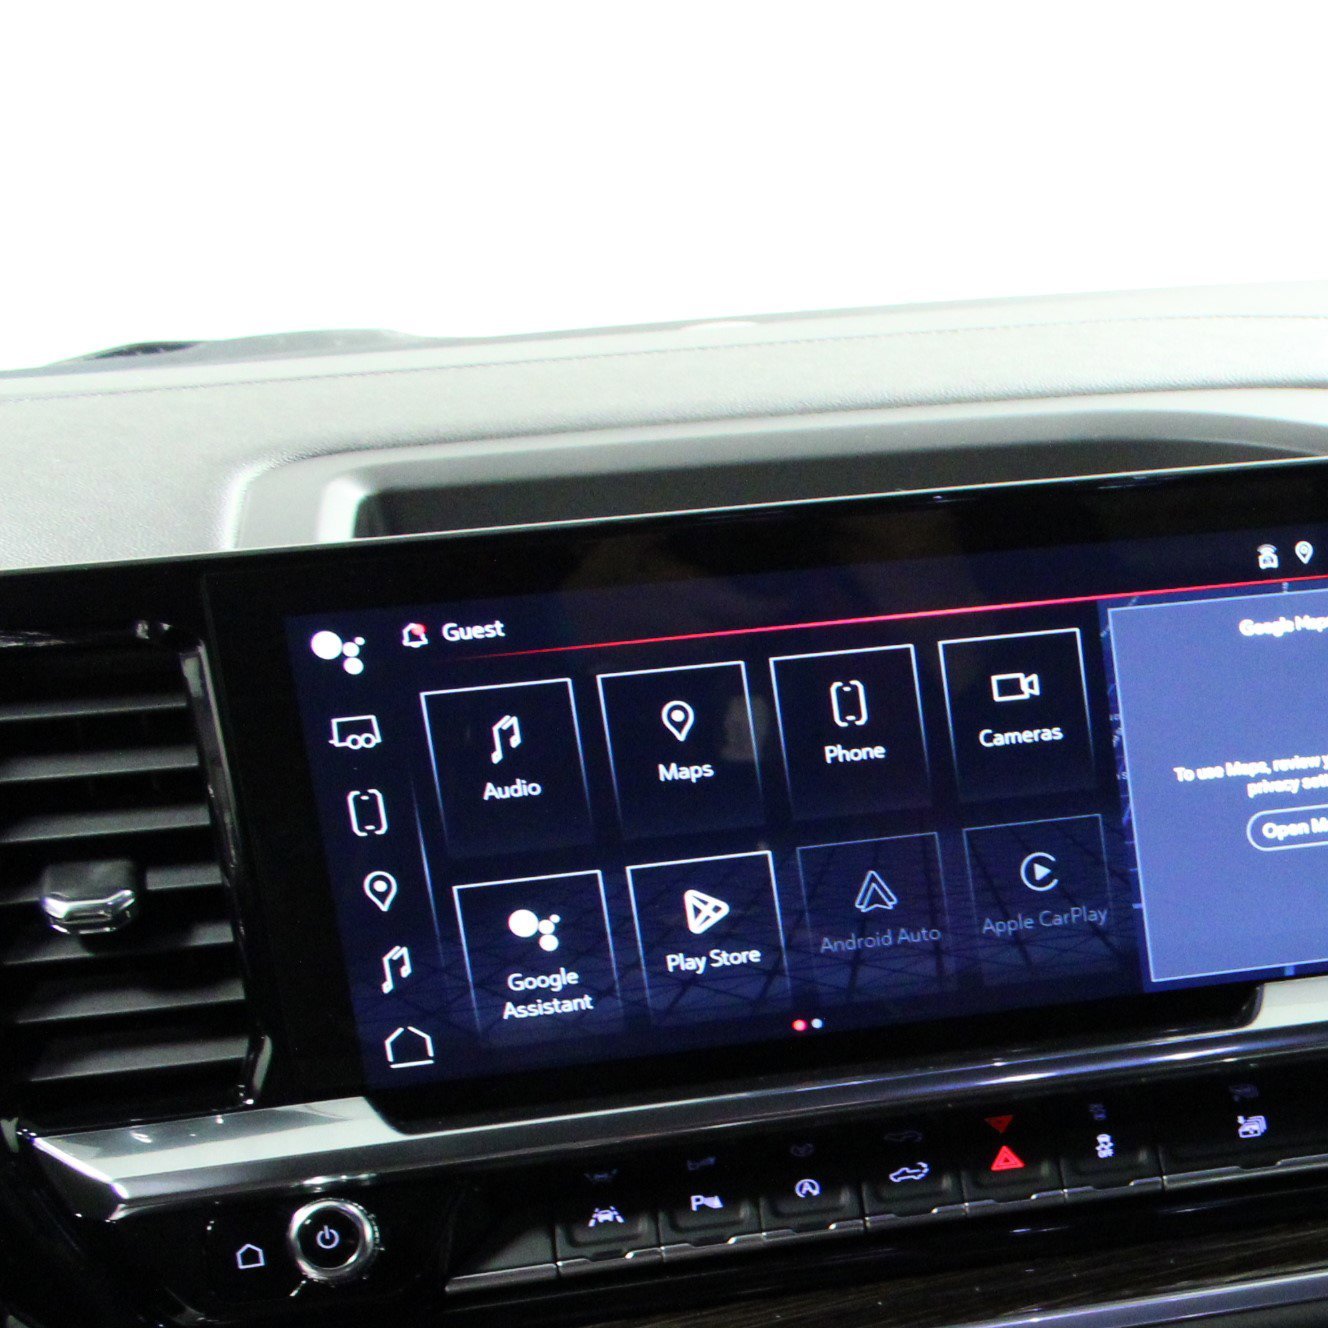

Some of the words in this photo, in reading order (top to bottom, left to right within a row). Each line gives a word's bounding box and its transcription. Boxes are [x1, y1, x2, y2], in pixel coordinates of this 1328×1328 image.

[441, 620, 506, 644] Guest
[1238, 615, 1294, 637] Google
[978, 724, 1064, 749] Cameras
[823, 741, 887, 765] Phone
[658, 759, 715, 786] Maps
[1173, 766, 1195, 783] To
[1196, 764, 1225, 781] use
[1225, 760, 1272, 778] Maps,
[1272, 755, 1321, 772] review
[482, 777, 542, 802] Audio
[1246, 776, 1300, 798] privacy
[1261, 819, 1310, 841] Open
[982, 910, 1034, 936] Apple
[1037, 903, 1108, 930] CarPlay
[819, 929, 893, 955] Android
[897, 925, 942, 946] Auto
[666, 950, 708, 978] Play
[710, 946, 761, 969] Store
[507, 967, 580, 994] Google
[502, 993, 594, 1021] Assistant
